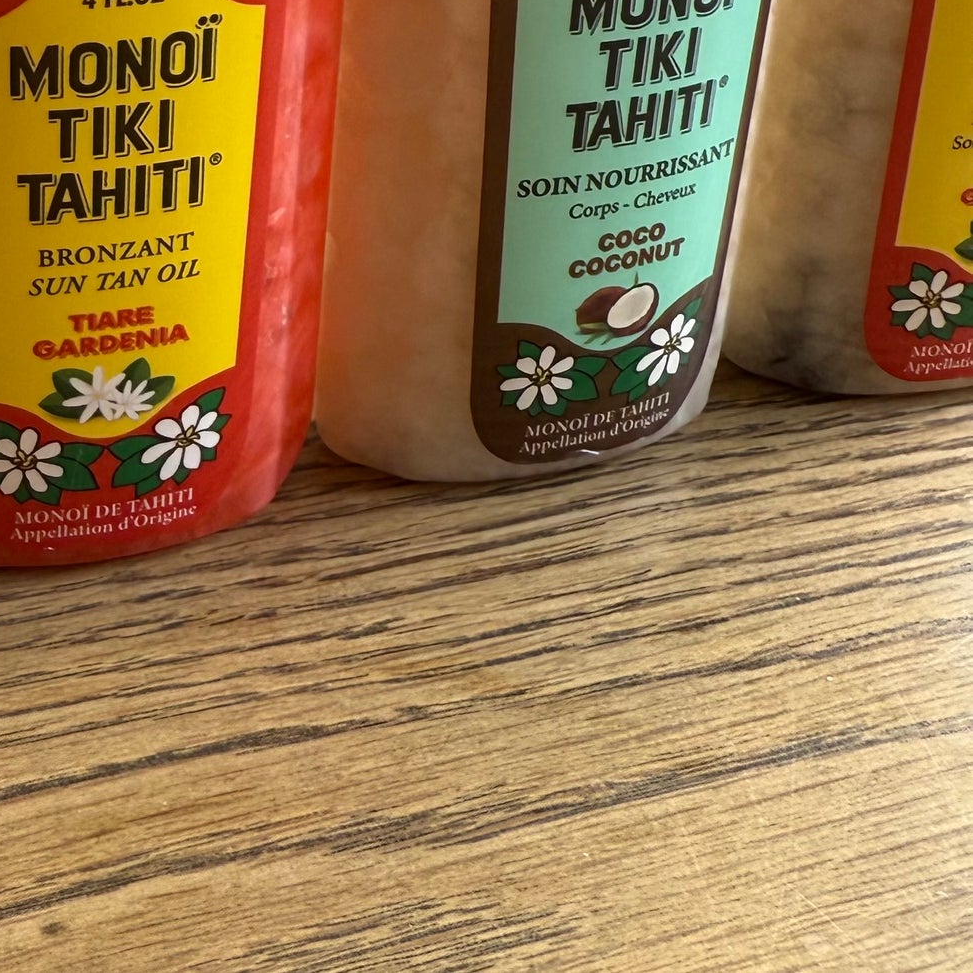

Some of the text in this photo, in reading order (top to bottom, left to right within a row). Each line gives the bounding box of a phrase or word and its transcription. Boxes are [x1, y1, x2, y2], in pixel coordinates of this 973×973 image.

[9, 13, 223, 101] MONOÏ
[599, 26, 703, 91] TIKI
[48, 99, 175, 162] TIKI
[517, 138, 735, 198] SOIN NOURRISSANT
[569, 201, 619, 220] Corps
[634, 183, 697, 209] Cheveux
[38, 231, 194, 268] BRONZANT
[598, 223, 666, 252] COCO
[569, 237, 685, 278] COCONUT
[29, 259, 200, 298] SUN TAN OIL
[68, 305, 155, 333] TIARE
[32, 323, 190, 361] GARDENIA
[525, 392, 670, 437] MONOÏ DE TAHITI
[519, 429, 606, 456] Appellation
[10, 505, 197, 543] Appellation d'Origine
[14, 487, 194, 525] MONOÏ DE TAHITI
